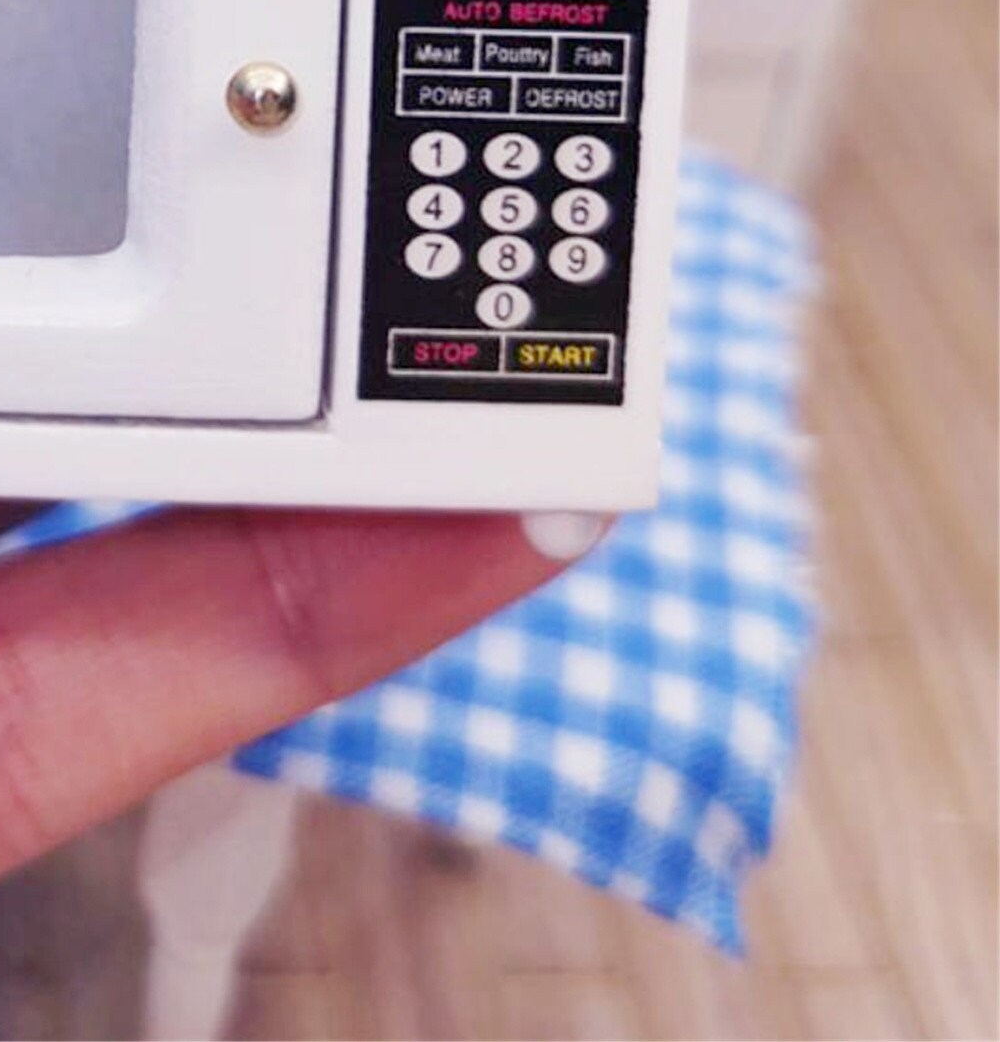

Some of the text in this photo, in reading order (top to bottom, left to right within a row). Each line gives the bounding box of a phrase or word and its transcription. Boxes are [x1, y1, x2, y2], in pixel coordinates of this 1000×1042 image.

[443, 1, 501, 21] AUTO
[415, 44, 461, 63] Meat
[573, 46, 612, 67] Fish
[419, 86, 493, 106] POWER
[525, 87, 619, 109] DEFROST
[430, 138, 594, 173] 1 2 3
[424, 192, 590, 226] 4 5 6
[425, 242, 588, 274] 7 8 9
[494, 292, 513, 322] 0
[414, 342, 478, 363] STOP
[519, 344, 597, 366] START
